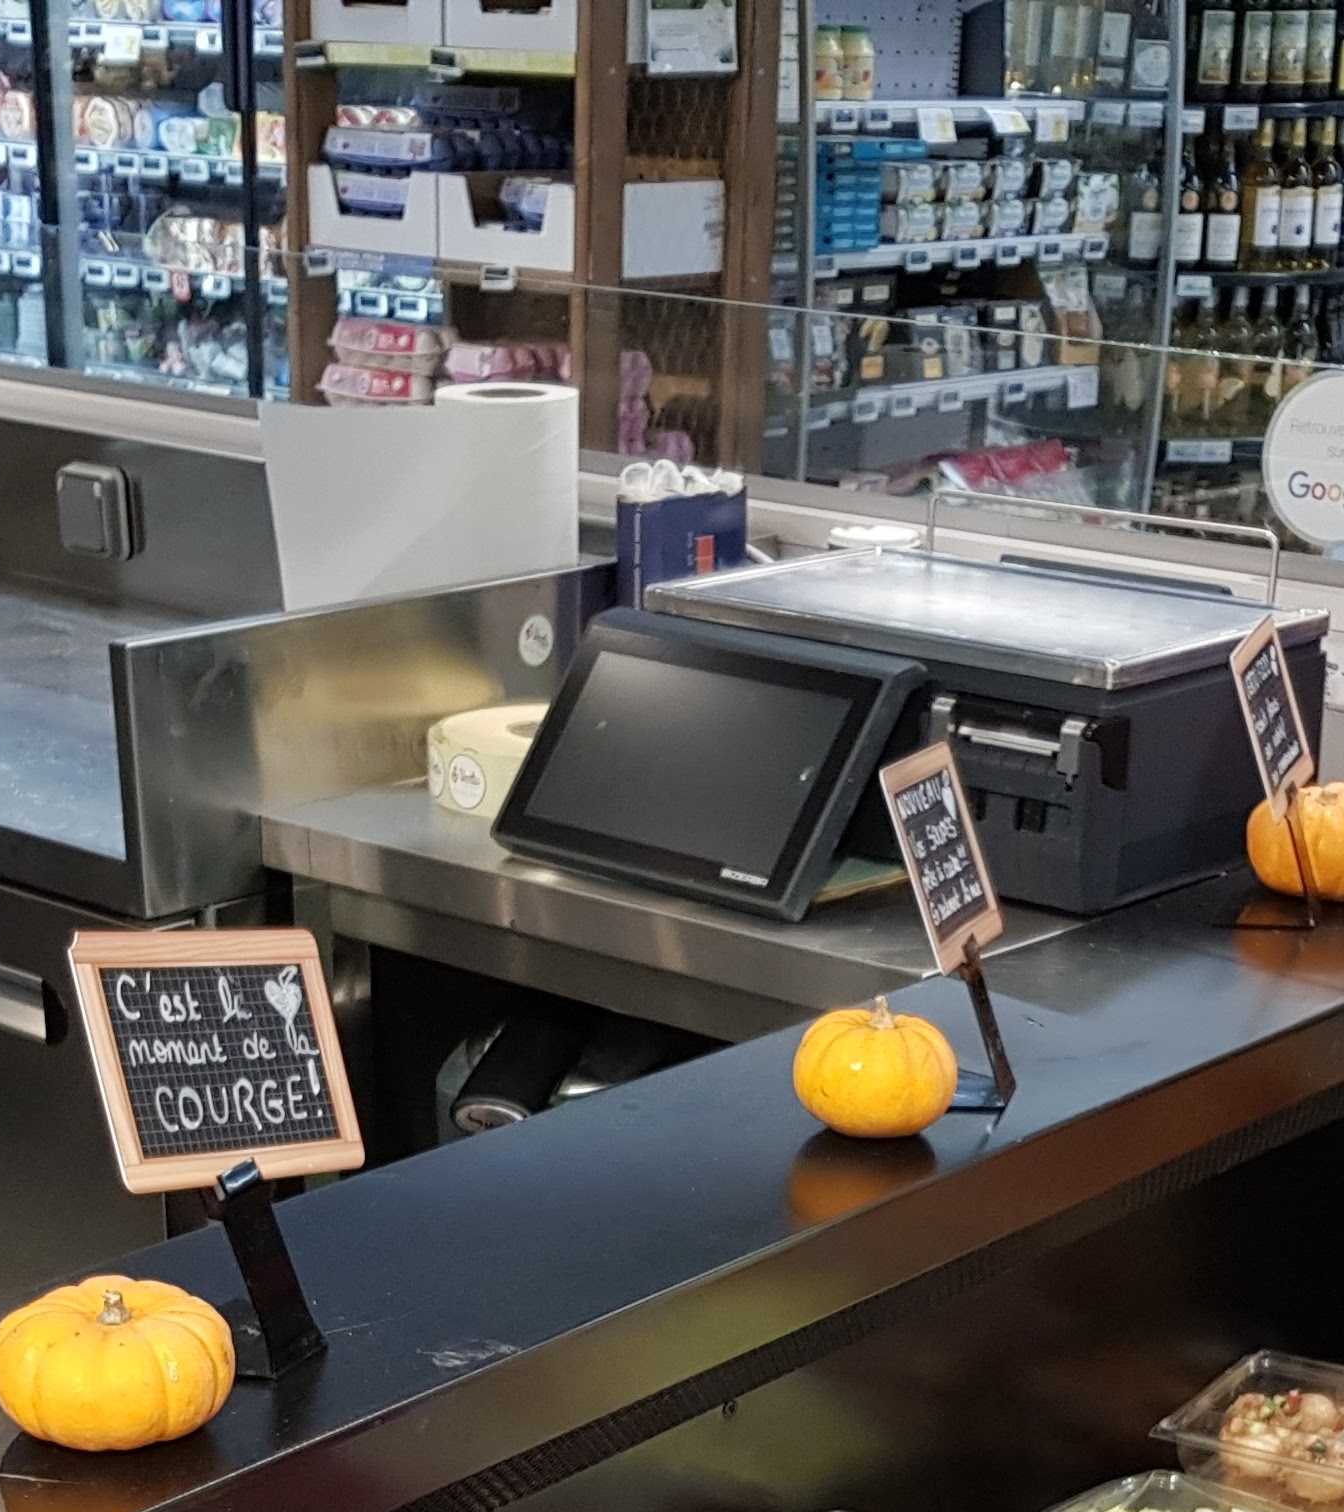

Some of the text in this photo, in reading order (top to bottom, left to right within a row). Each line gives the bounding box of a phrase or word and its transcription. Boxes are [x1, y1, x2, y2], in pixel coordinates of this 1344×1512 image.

[116, 972, 202, 1023] C'est
[128, 1020, 320, 1067] moment de la
